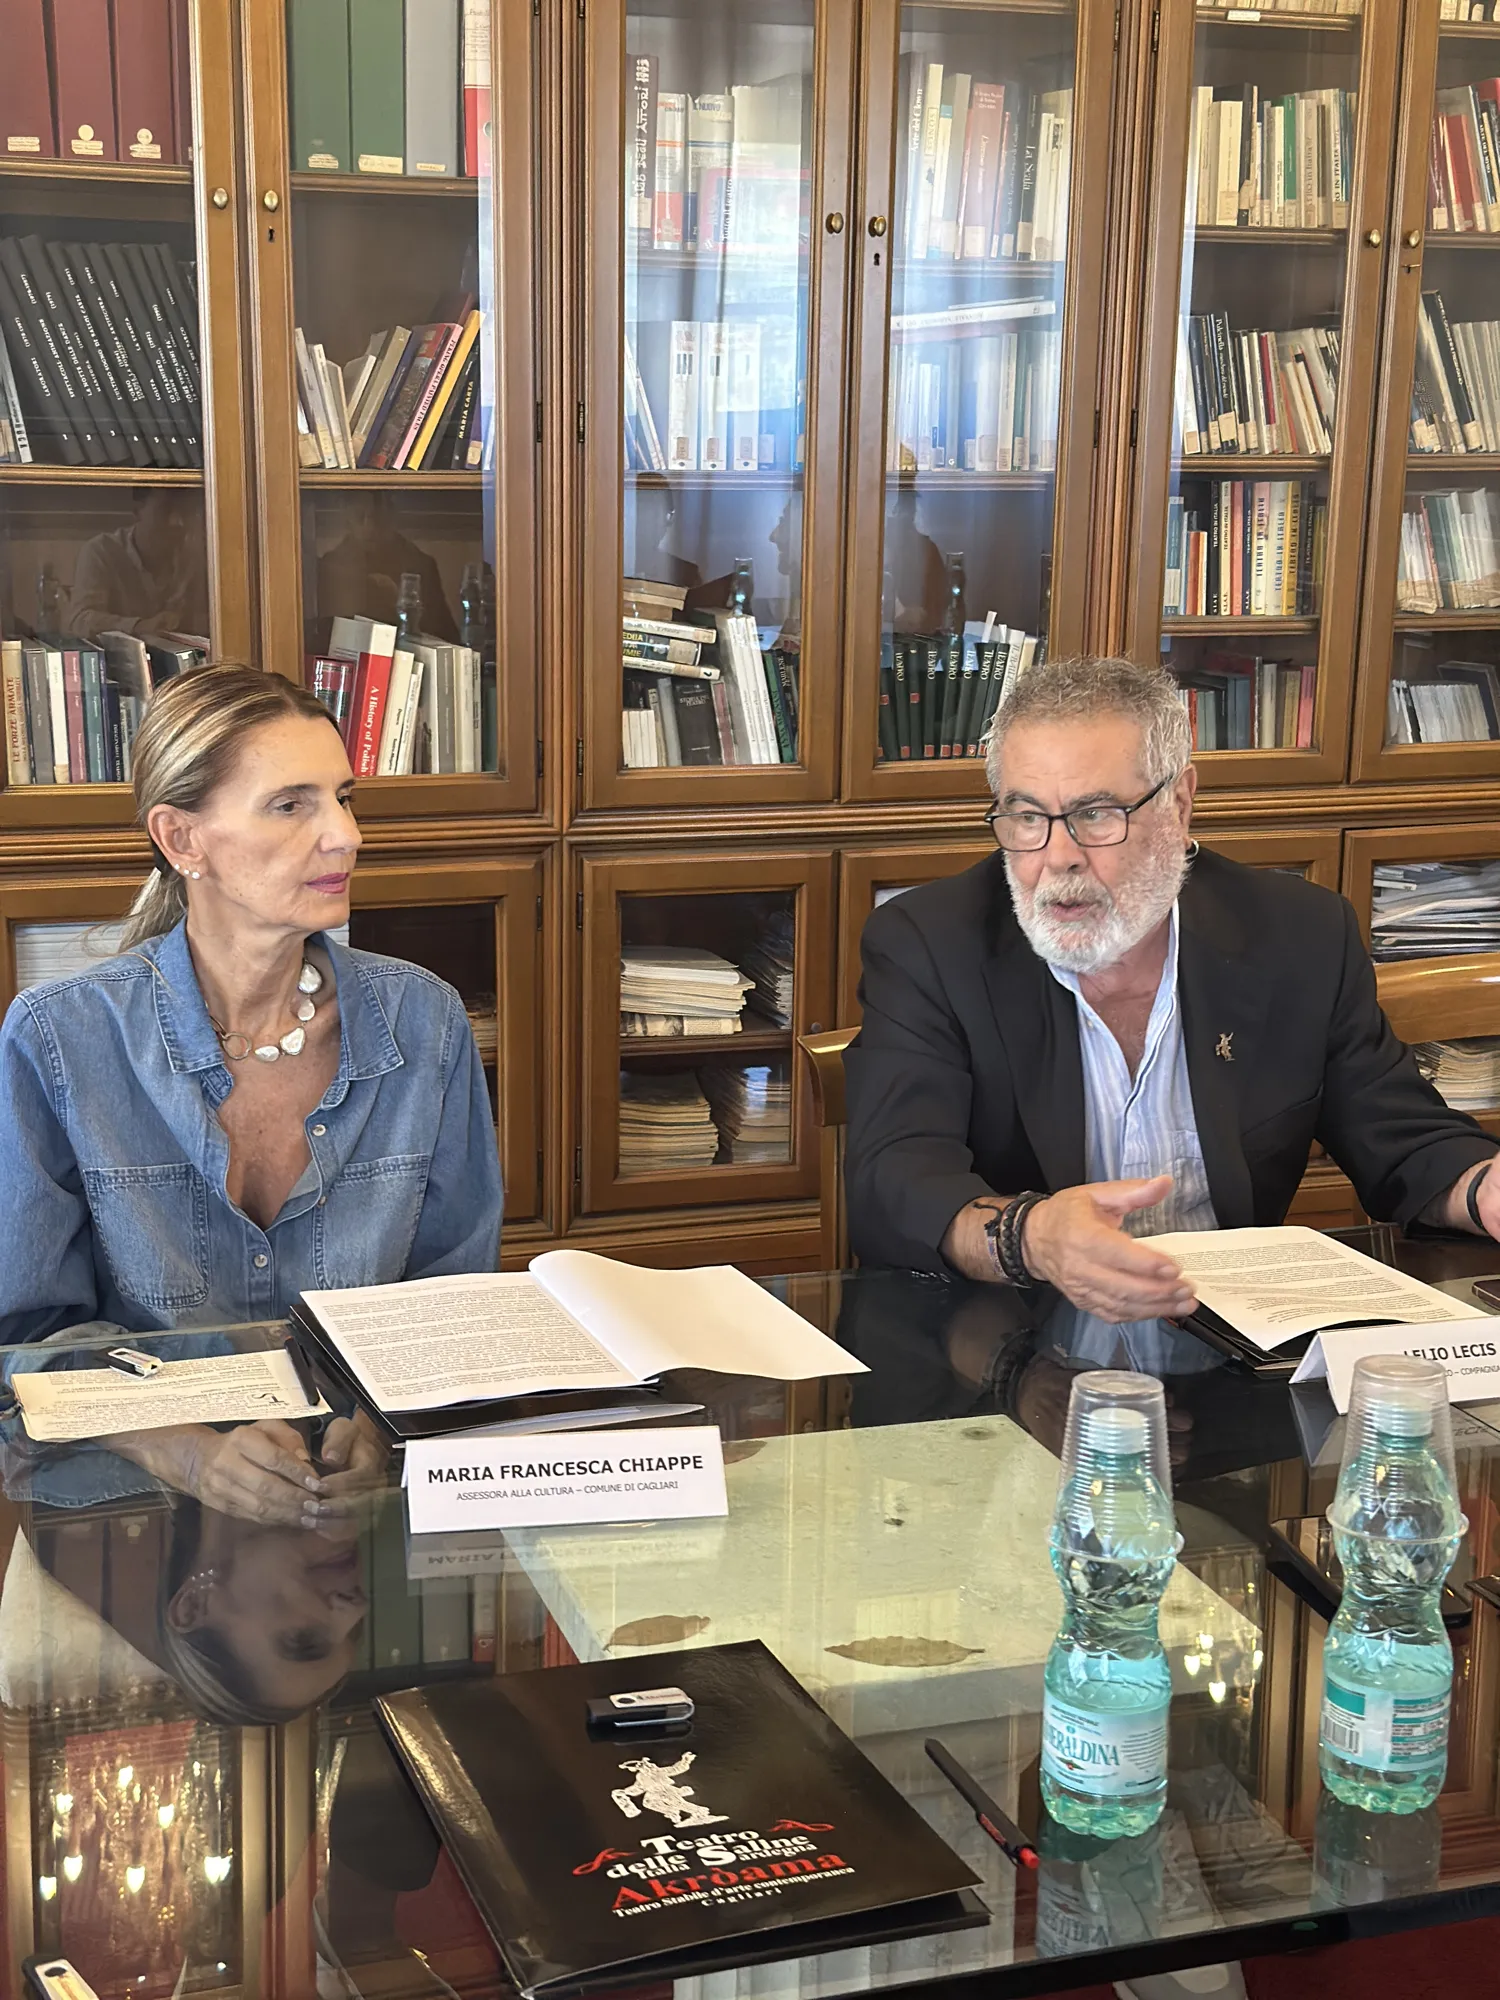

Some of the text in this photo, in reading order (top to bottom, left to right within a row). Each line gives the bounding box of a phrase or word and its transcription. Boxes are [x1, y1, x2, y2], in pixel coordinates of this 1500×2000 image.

[1022, 146, 1036, 190] La Scala
[458, 381, 474, 438] MARIA CARTA
[778, 656, 788, 687] MARLENE
[928, 650, 937, 680] TEATRO
[948, 650, 960, 680] TEATRO
[980, 650, 994, 680] TEATRO
[994, 651, 1008, 680] TEATRO
[8, 678, 16, 714] ARMATE
[364, 696, 378, 730] History
[10, 721, 19, 750] FORZE
[361, 743, 372, 773] Polish
[1452, 1343, 1497, 1359] LECIS
[428, 1456, 704, 1484] MARIA FRANCESCA CHIAPPE
[456, 1490, 508, 1501] ASSESSORA
[510, 1488, 532, 1498] ALLA
[534, 1486, 574, 1497] CULTURA
[584, 1484, 622, 1494] COMUNE
[625, 1482, 636, 1491] DI
[637, 1480, 679, 1492] CAGLIARI
[1048, 1726, 1120, 1766] ERALDINA
[607, 1834, 810, 1879] delle Saline
[640, 1830, 760, 1855] Teatro
[638, 1862, 691, 1880] Italia
[612, 1866, 856, 1918] Teatro Stabile d'arte contemporanea
[702, 1888, 782, 1908] Cagliari
